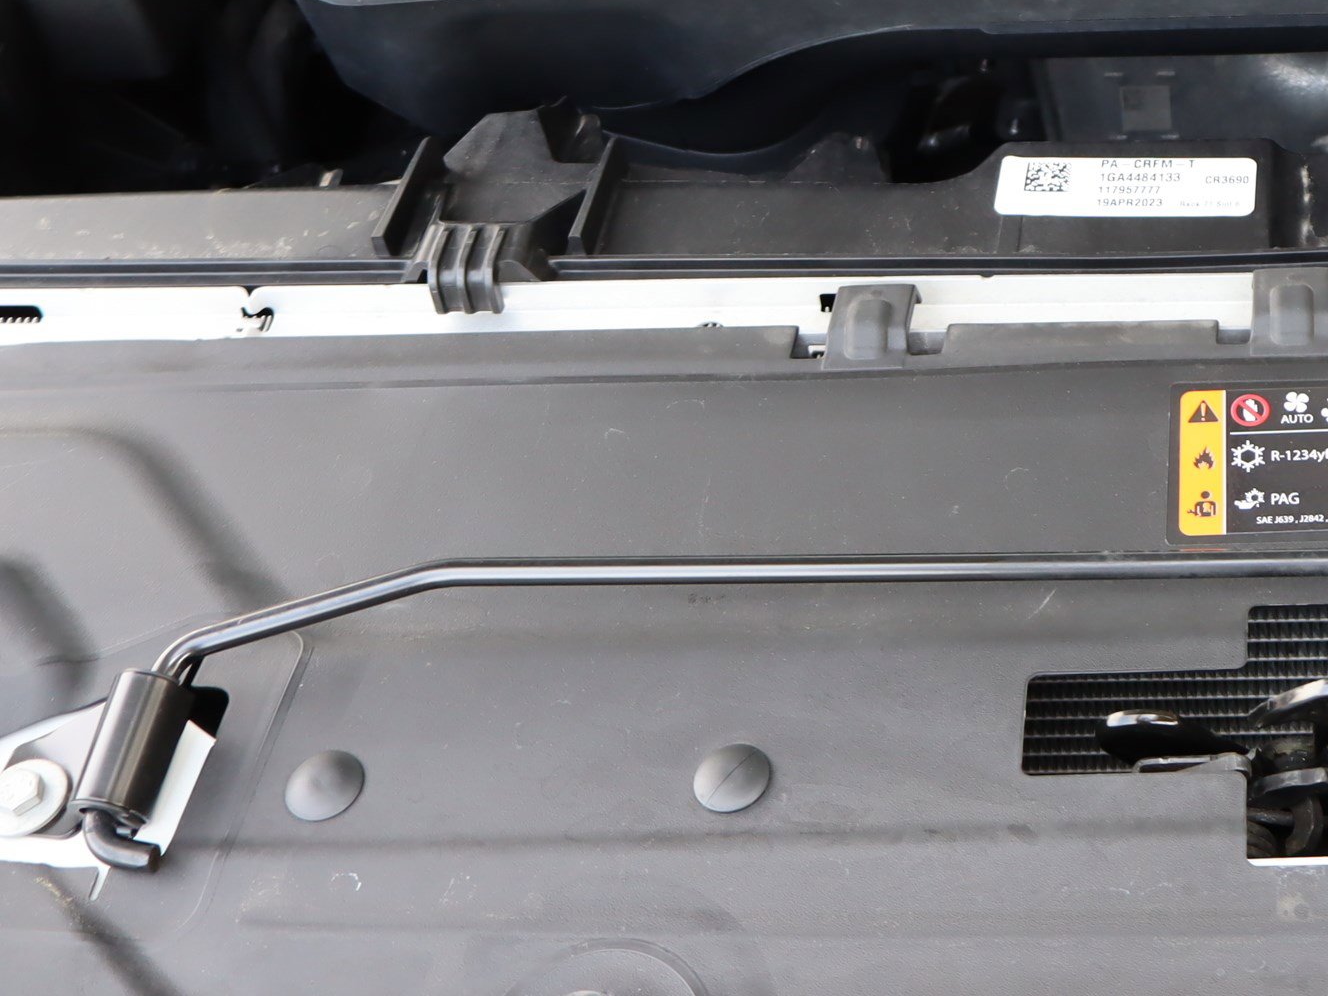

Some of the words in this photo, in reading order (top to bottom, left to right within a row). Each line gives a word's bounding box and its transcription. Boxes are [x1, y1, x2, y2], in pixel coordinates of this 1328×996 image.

[1097, 198, 1163, 207] 19APR2023
[1281, 413, 1314, 424] AUTO
[1270, 492, 1300, 505] PAG
[1256, 515, 1273, 524] SAE
